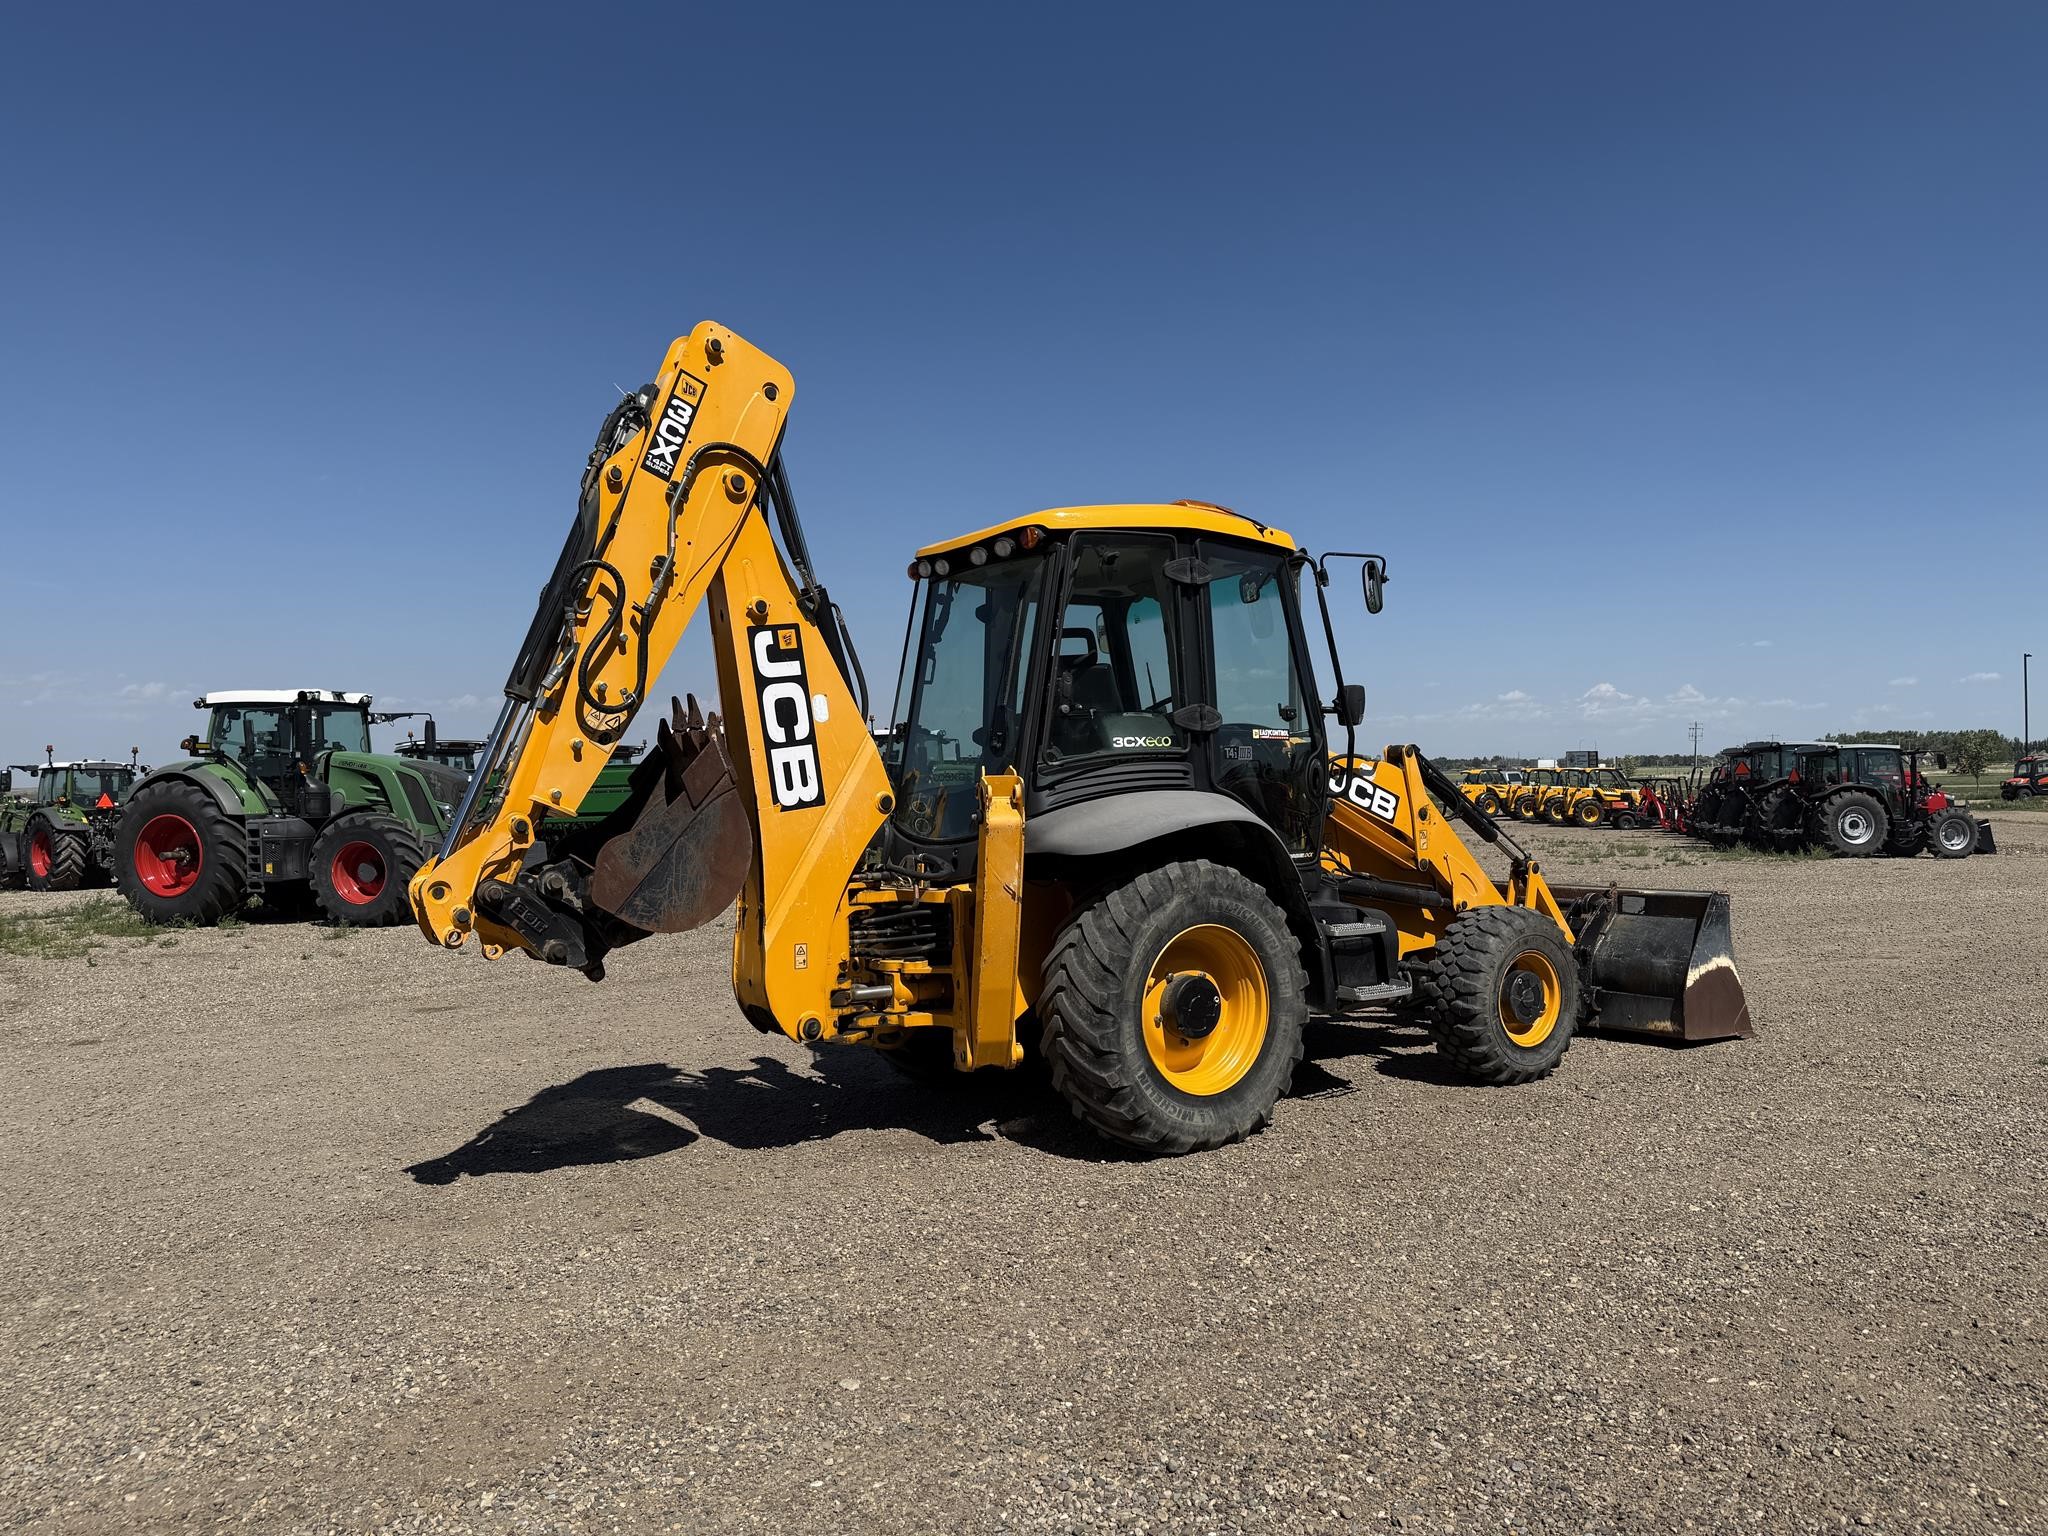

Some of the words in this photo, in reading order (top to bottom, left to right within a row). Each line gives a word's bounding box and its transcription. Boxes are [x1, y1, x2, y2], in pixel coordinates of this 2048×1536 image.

[683, 379, 698, 397] JCB
[649, 398, 693, 466] 3CX
[645, 461, 670, 477] SUPER
[647, 454, 674, 472] 14FT
[754, 631, 819, 806] JCB
[1112, 736, 1172, 748] 3CXeco
[1328, 771, 1397, 820] JCB
[1135, 1070, 1196, 1122] MICHELIN
